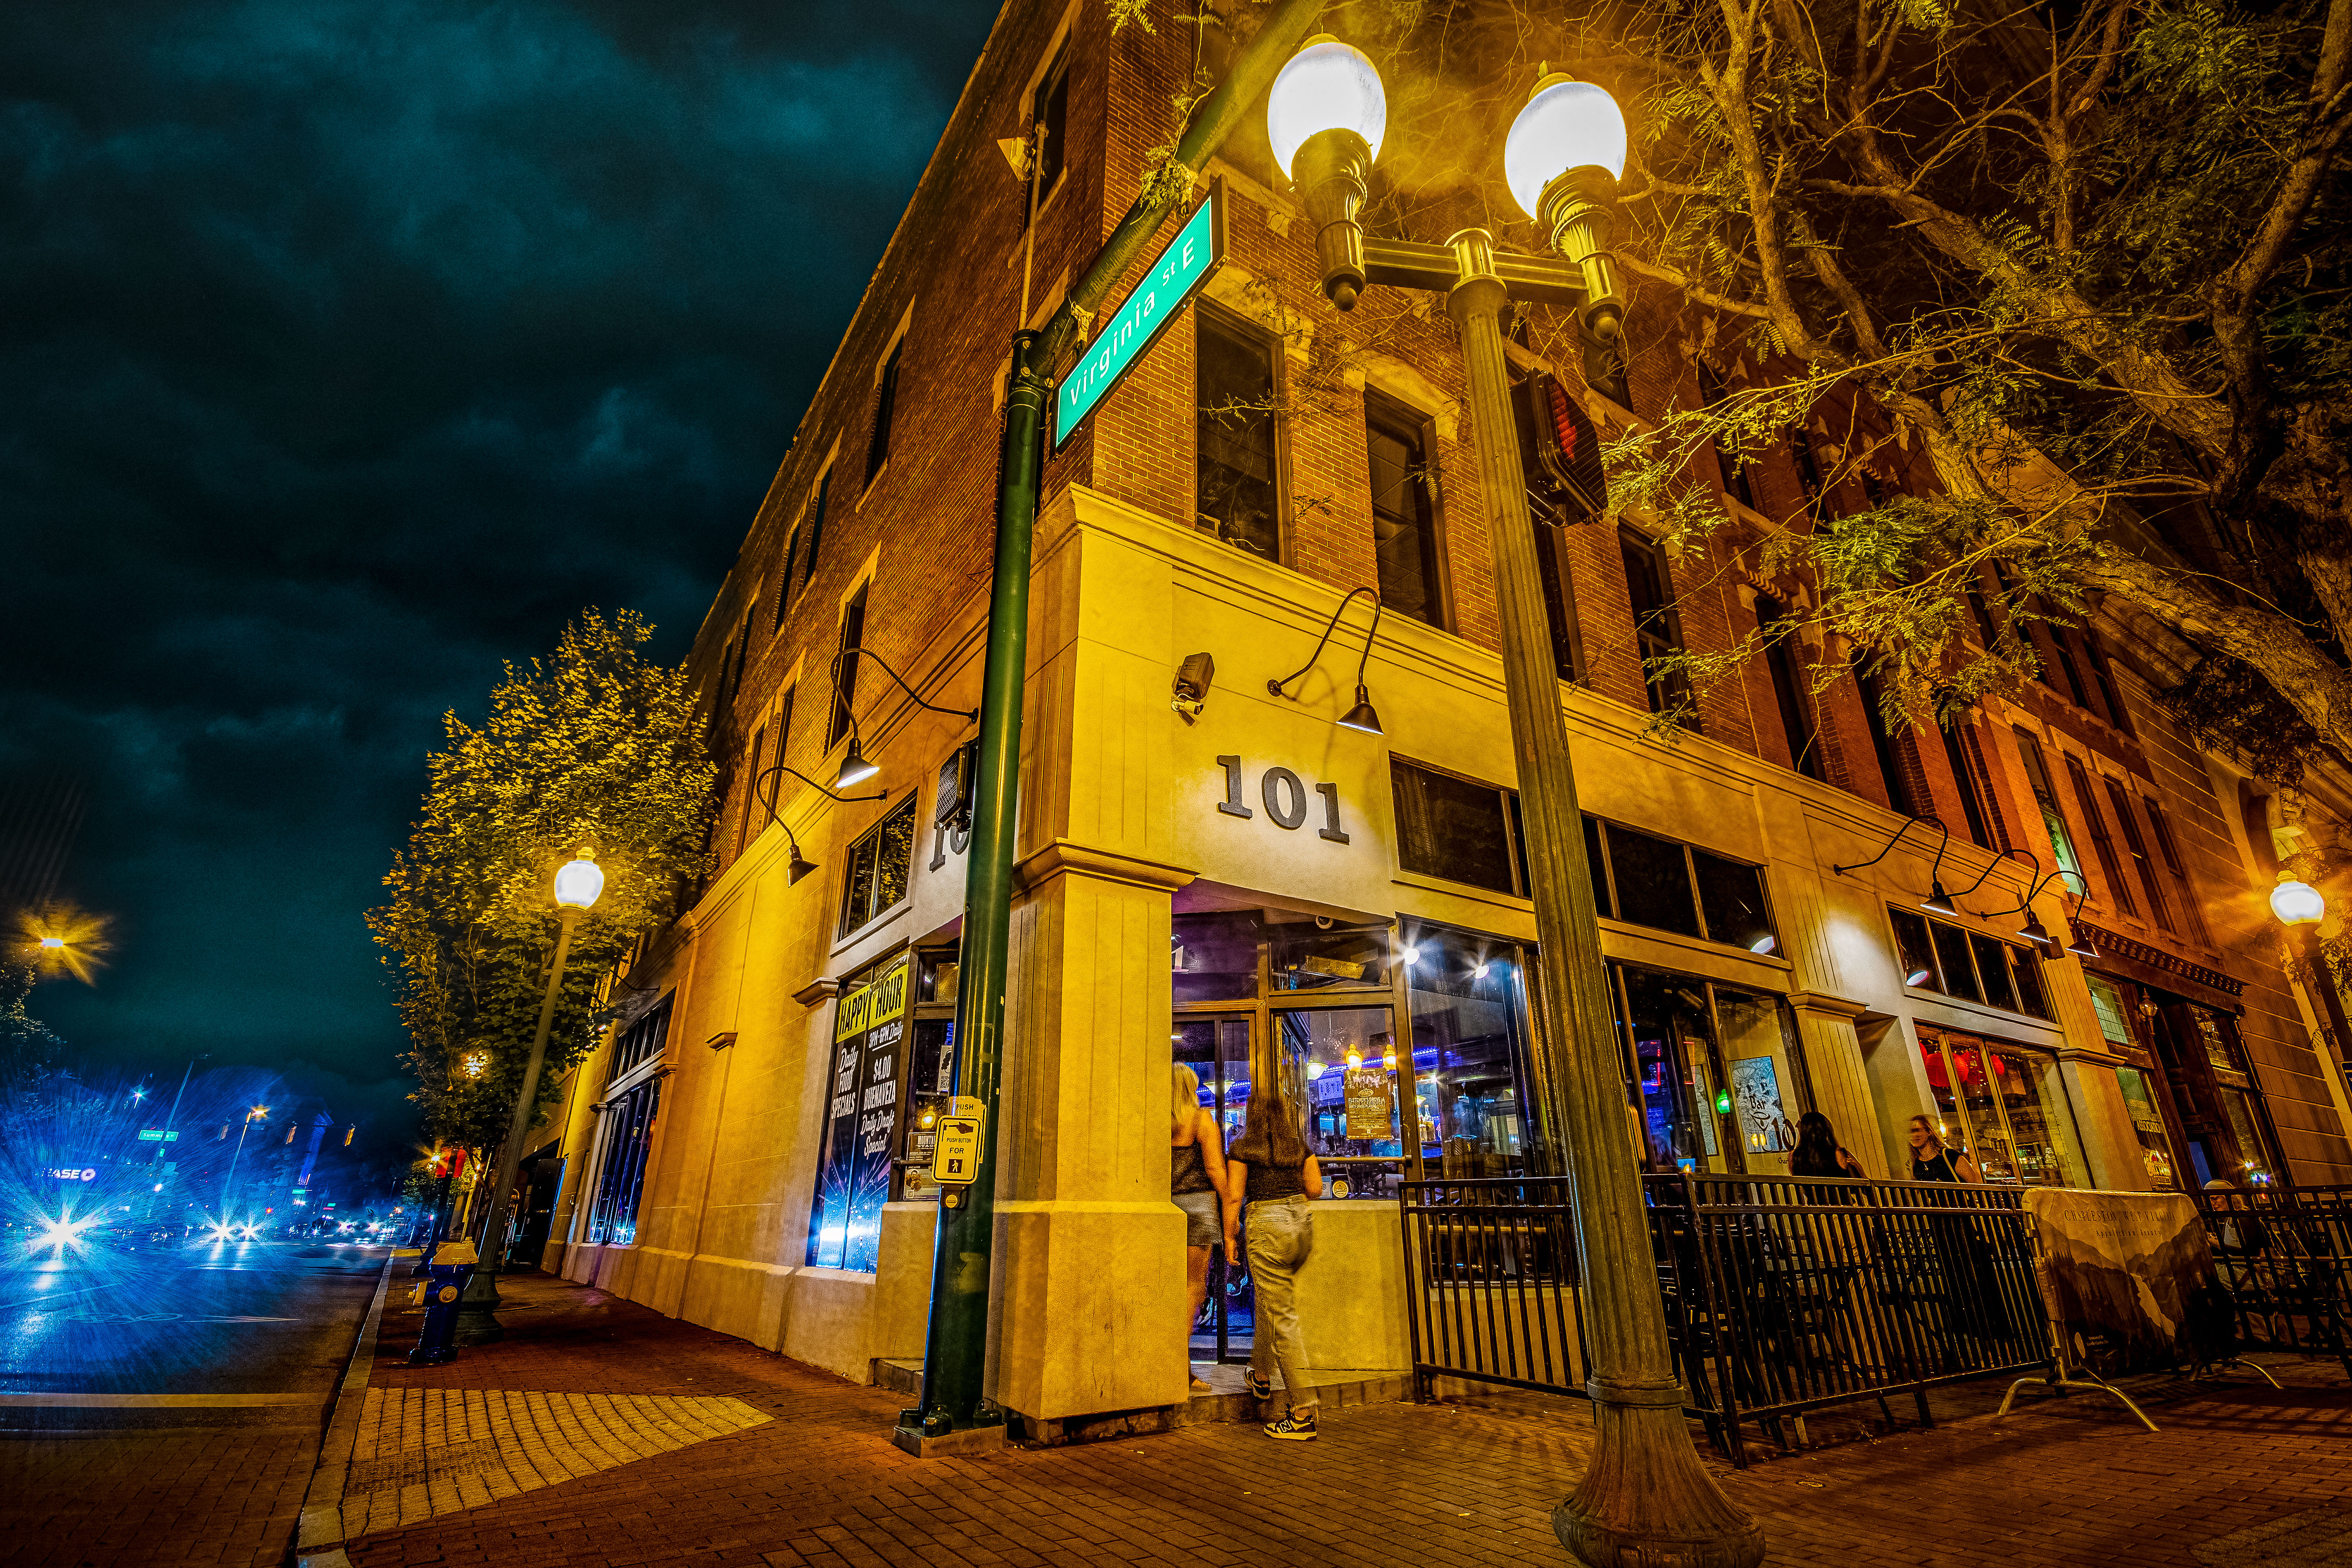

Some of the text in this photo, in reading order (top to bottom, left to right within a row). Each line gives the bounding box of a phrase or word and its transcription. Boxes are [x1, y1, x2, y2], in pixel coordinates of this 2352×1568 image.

[1070, 236, 1195, 406] Virginia St E
[1217, 754, 1351, 845] 101
[839, 973, 904, 1036] HAPPY HOUR
[889, 1021, 903, 1040] Daily
[839, 1045, 858, 1073] Daily
[874, 1055, 891, 1083] $4.00
[839, 1070, 853, 1094] FOOD
[863, 1080, 896, 1111] BUENAVEZA
[831, 1092, 855, 1120] SPECIALS
[1749, 1094, 1766, 1110] Bar
[860, 1110, 894, 1137] Daily Draft
[1771, 1117, 1801, 1153] 10
[864, 1133, 887, 1160] Special
[2123, 1211, 2141, 1221] WEST
[2144, 1211, 2176, 1221] VIRGINIA
[2140, 1229, 2162, 1237] Beauty
[1280, 1420, 1292, 1432] N
